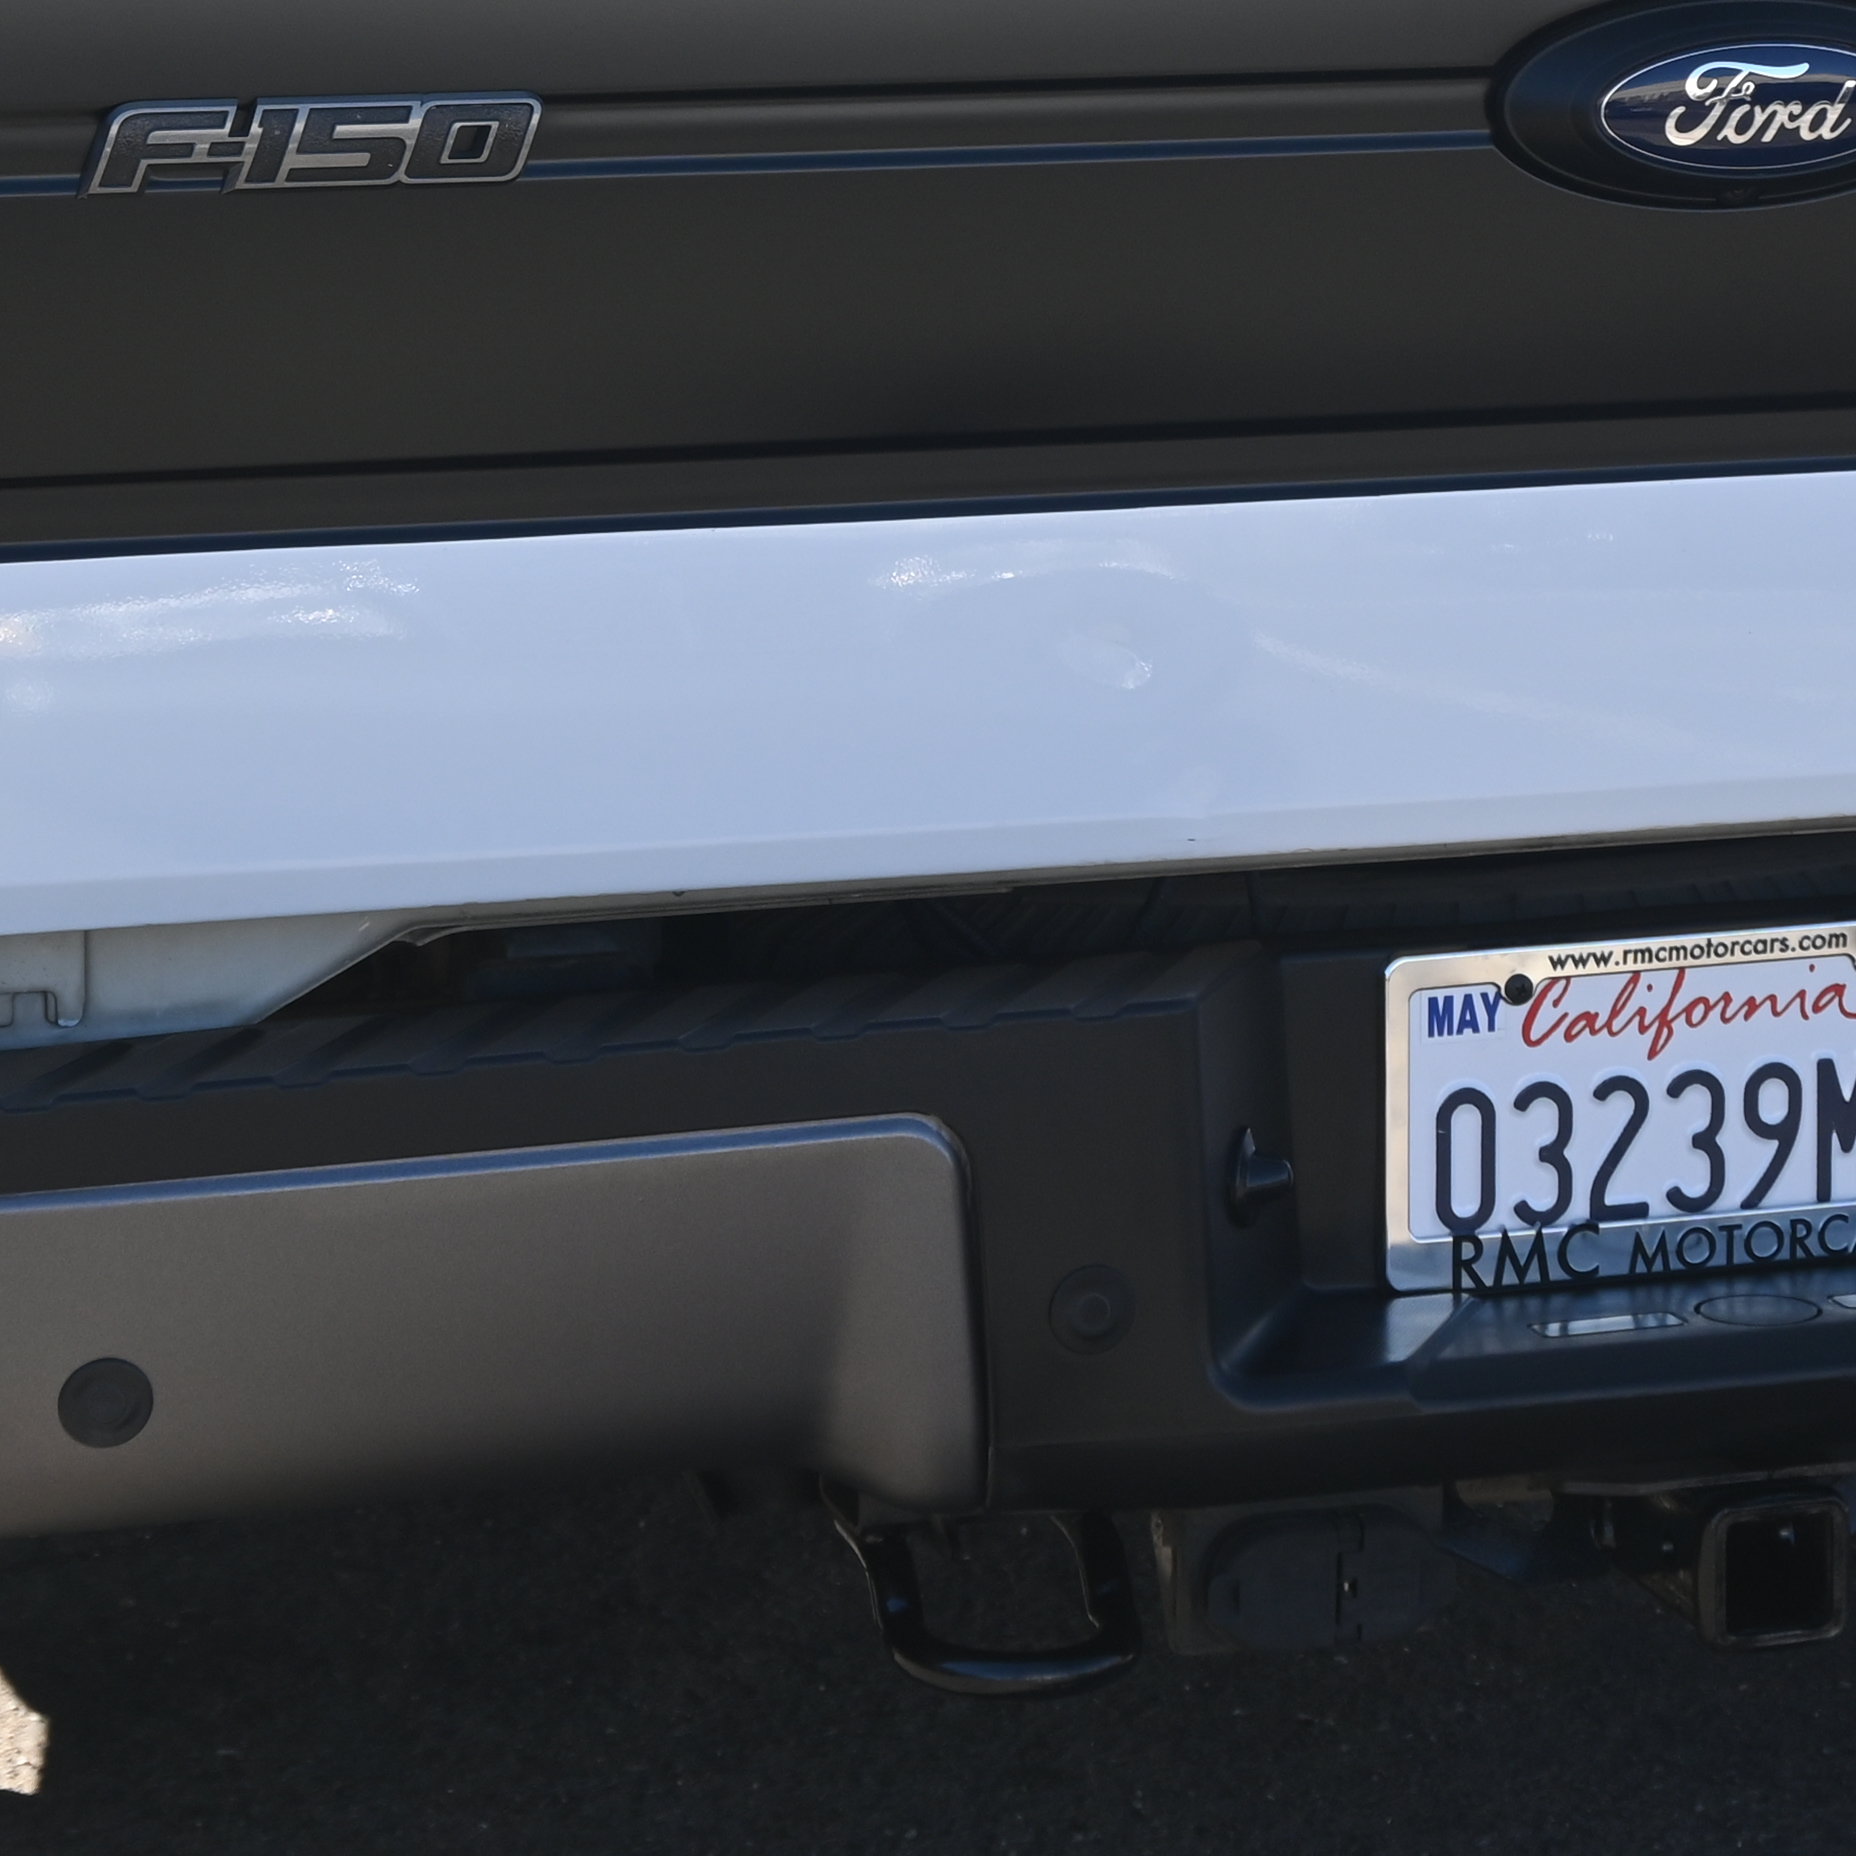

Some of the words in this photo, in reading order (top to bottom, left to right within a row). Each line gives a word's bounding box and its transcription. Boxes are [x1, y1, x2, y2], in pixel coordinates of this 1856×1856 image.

[79, 92, 543, 196] F-150
[1547, 929, 1848, 972] www.rmcmotorcars.com
[1426, 992, 1501, 1037] MAY
[1451, 1223, 1600, 1294] RMC
